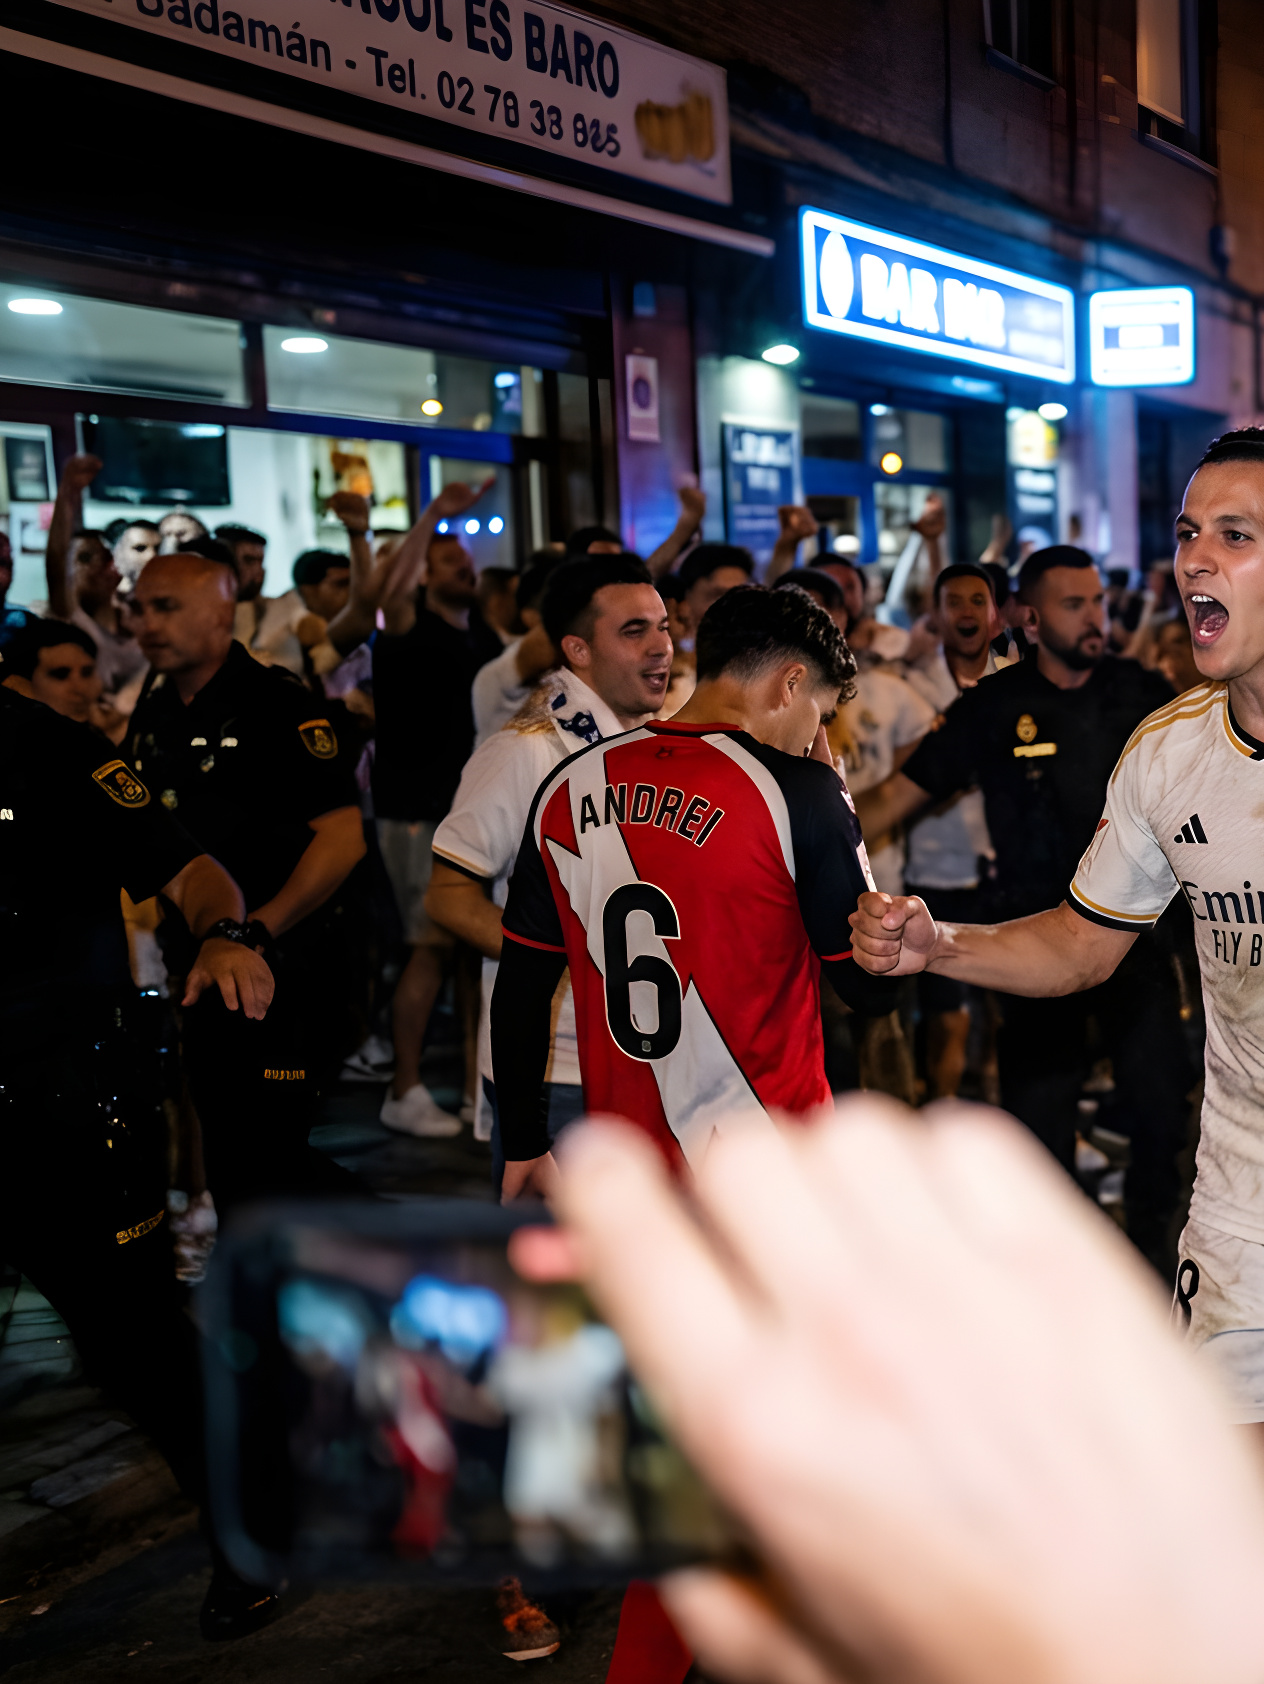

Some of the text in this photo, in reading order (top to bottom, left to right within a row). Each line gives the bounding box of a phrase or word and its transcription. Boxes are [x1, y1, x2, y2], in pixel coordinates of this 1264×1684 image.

[366, 46, 426, 100] Tel.
[437, 70, 475, 116] 02
[484, 84, 519, 128] 78
[465, 0, 513, 61] ES
[524, 11, 619, 98] BARO
[580, 783, 725, 848] ANDREI
[602, 881, 682, 1063] 6
[1211, 928, 1242, 965] FLY
